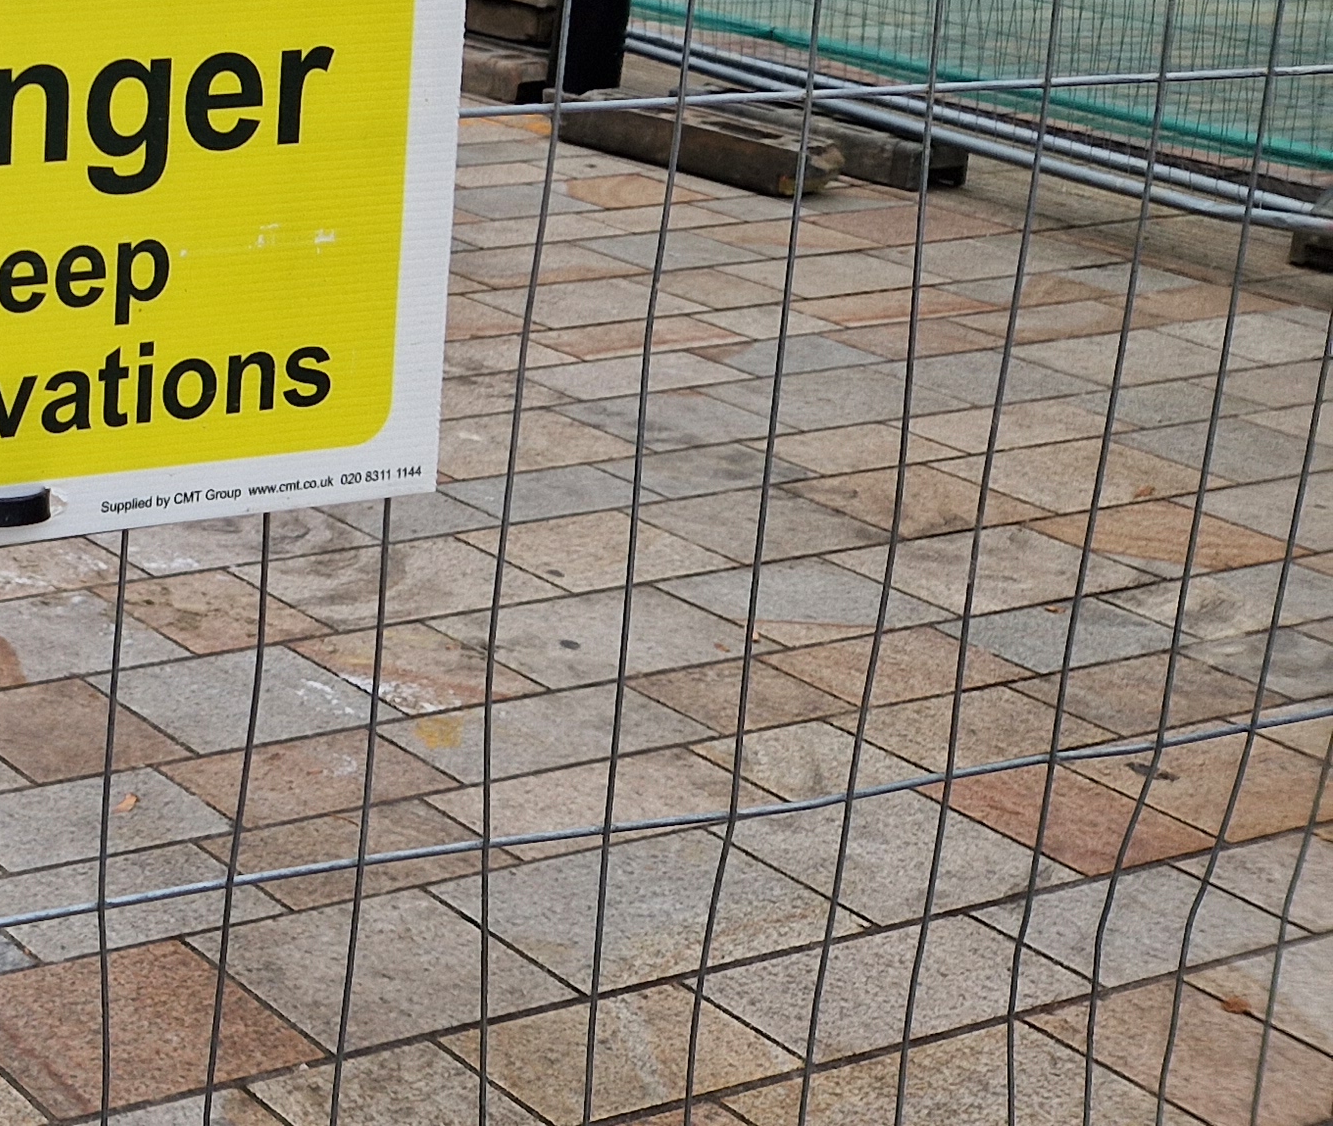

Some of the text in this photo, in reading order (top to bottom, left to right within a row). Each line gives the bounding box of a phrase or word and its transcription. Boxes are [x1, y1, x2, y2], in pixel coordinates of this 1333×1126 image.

[100, 465, 422, 514] Supplied by CMT Group www.cmt.co.uk 020 8311 1144
